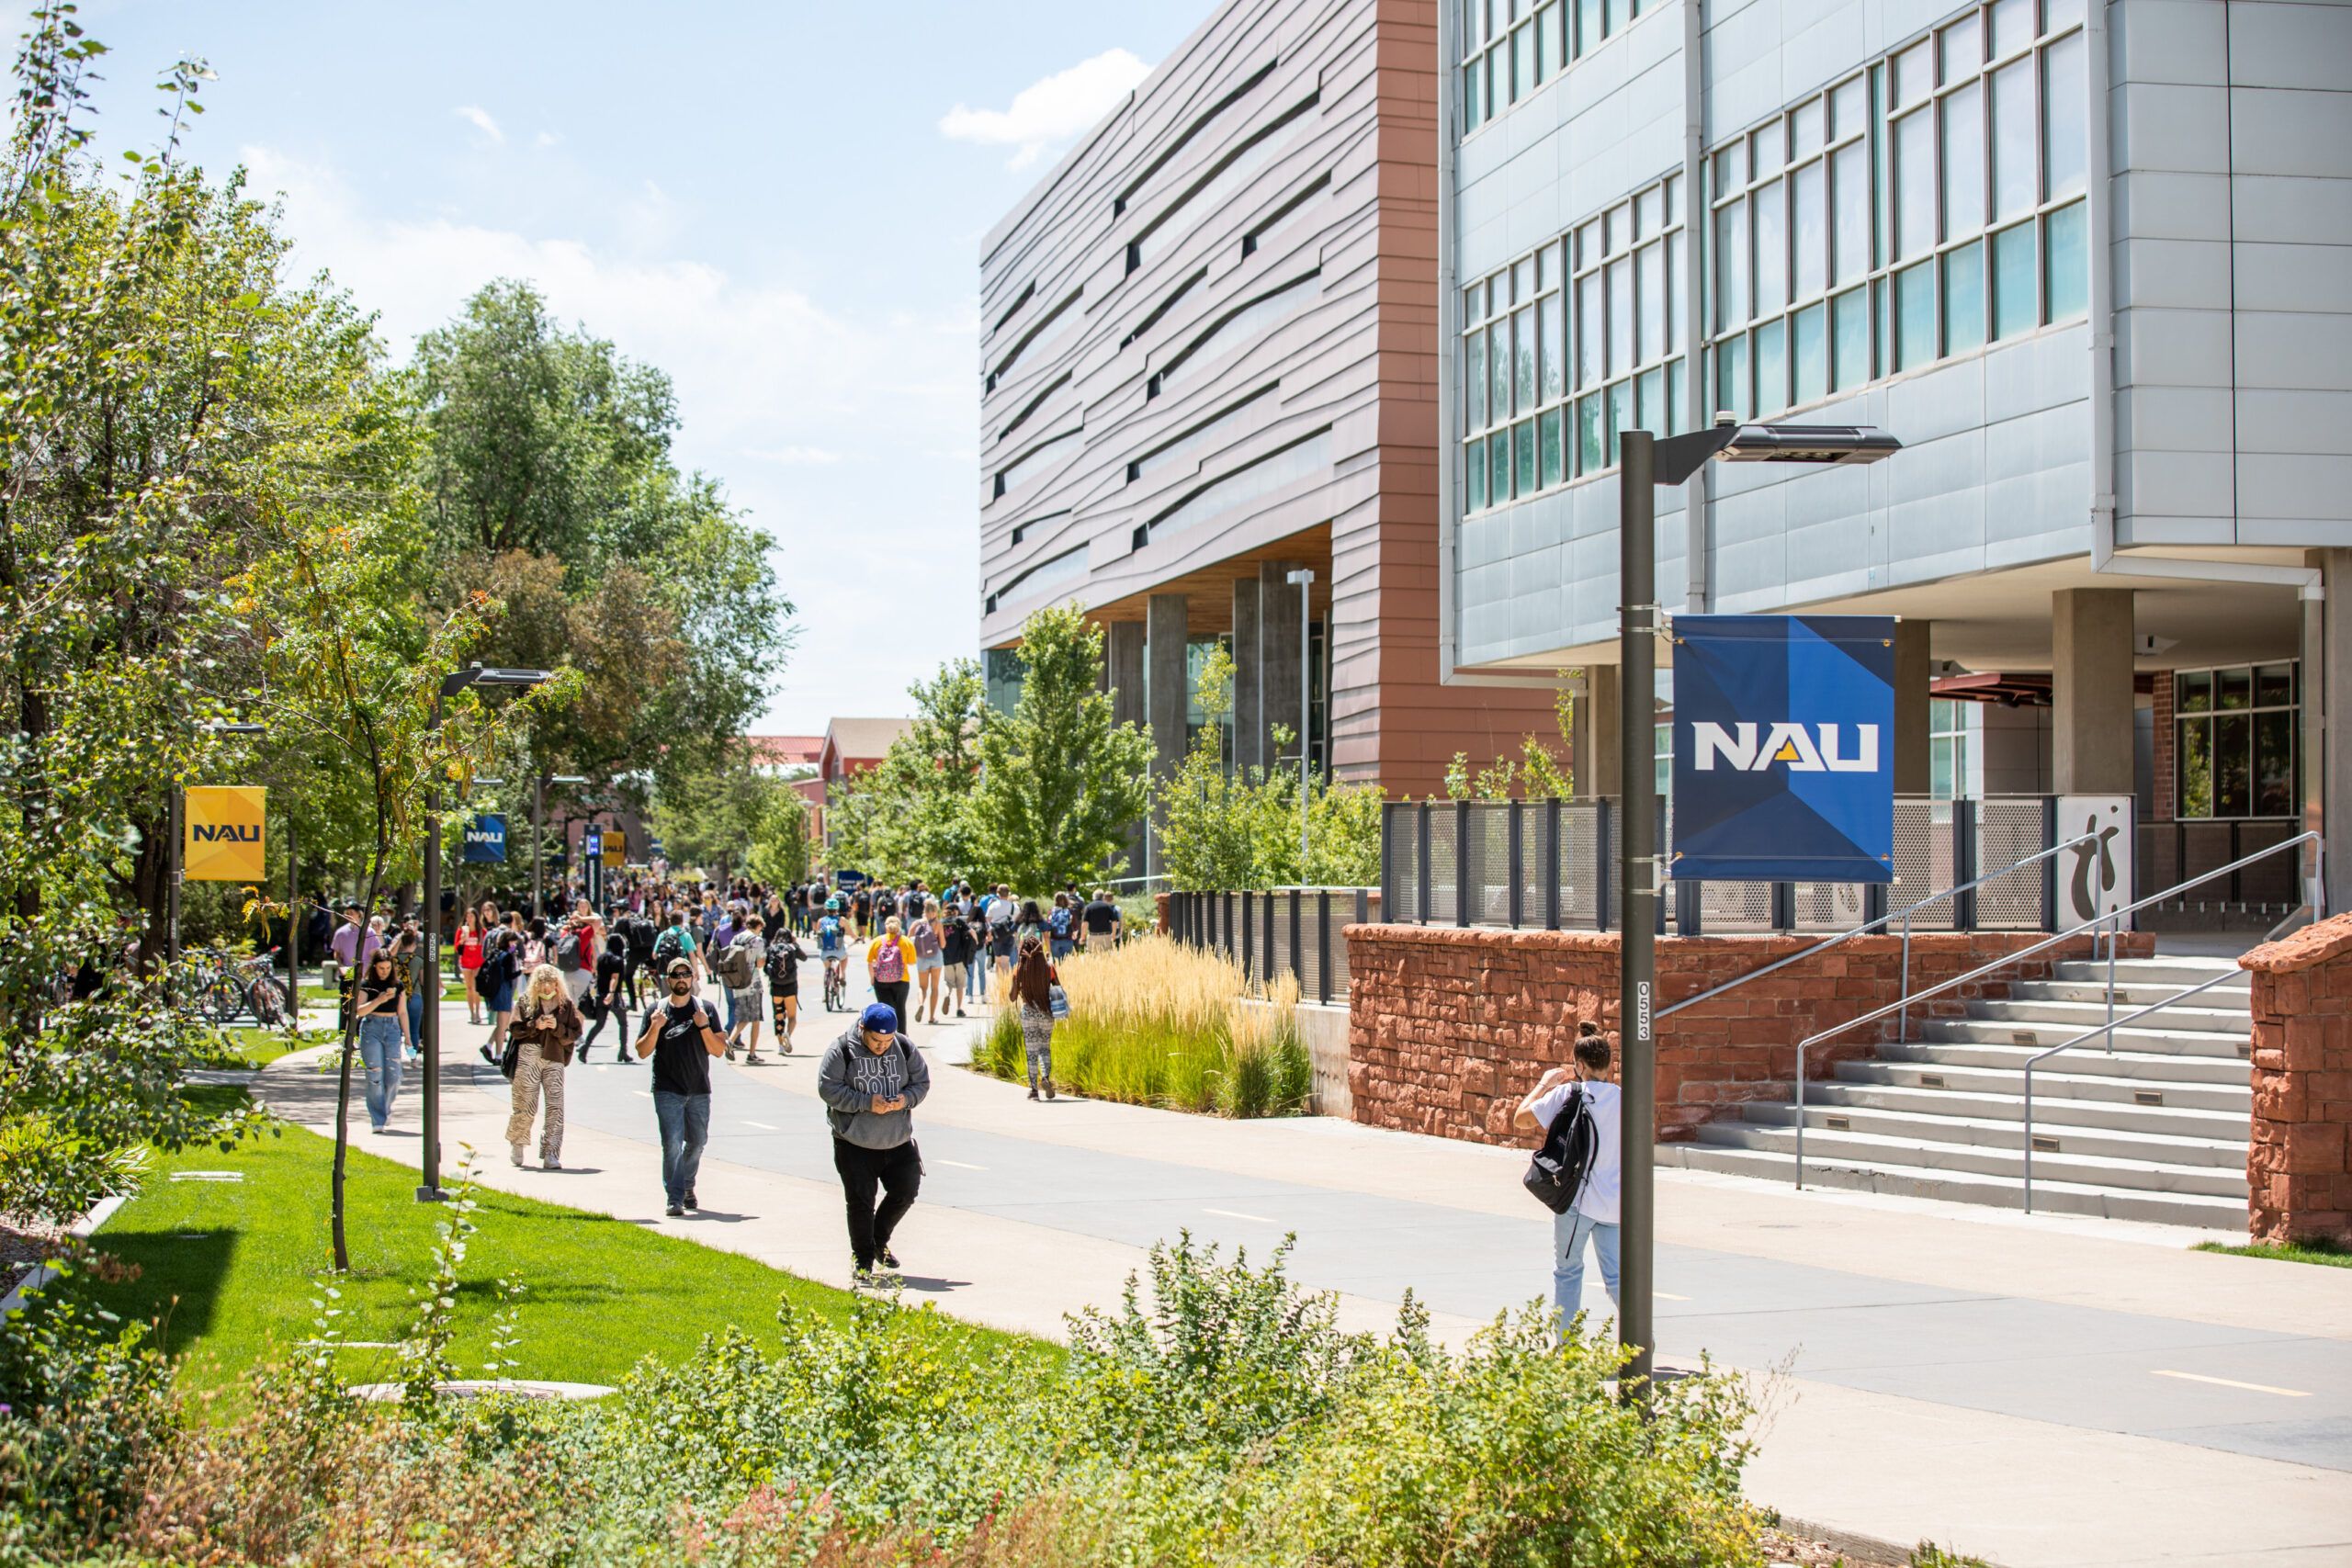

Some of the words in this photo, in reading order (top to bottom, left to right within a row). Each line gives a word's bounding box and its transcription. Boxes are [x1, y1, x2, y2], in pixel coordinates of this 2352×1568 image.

[1690, 721, 1879, 773] NAU
[192, 824, 260, 842] NAU
[467, 831, 503, 843] NAU
[1639, 983, 1649, 1039] 0553
[855, 1055, 897, 1078] JUST
[854, 1077, 882, 1095] DO
[883, 1075, 900, 1098] IT
